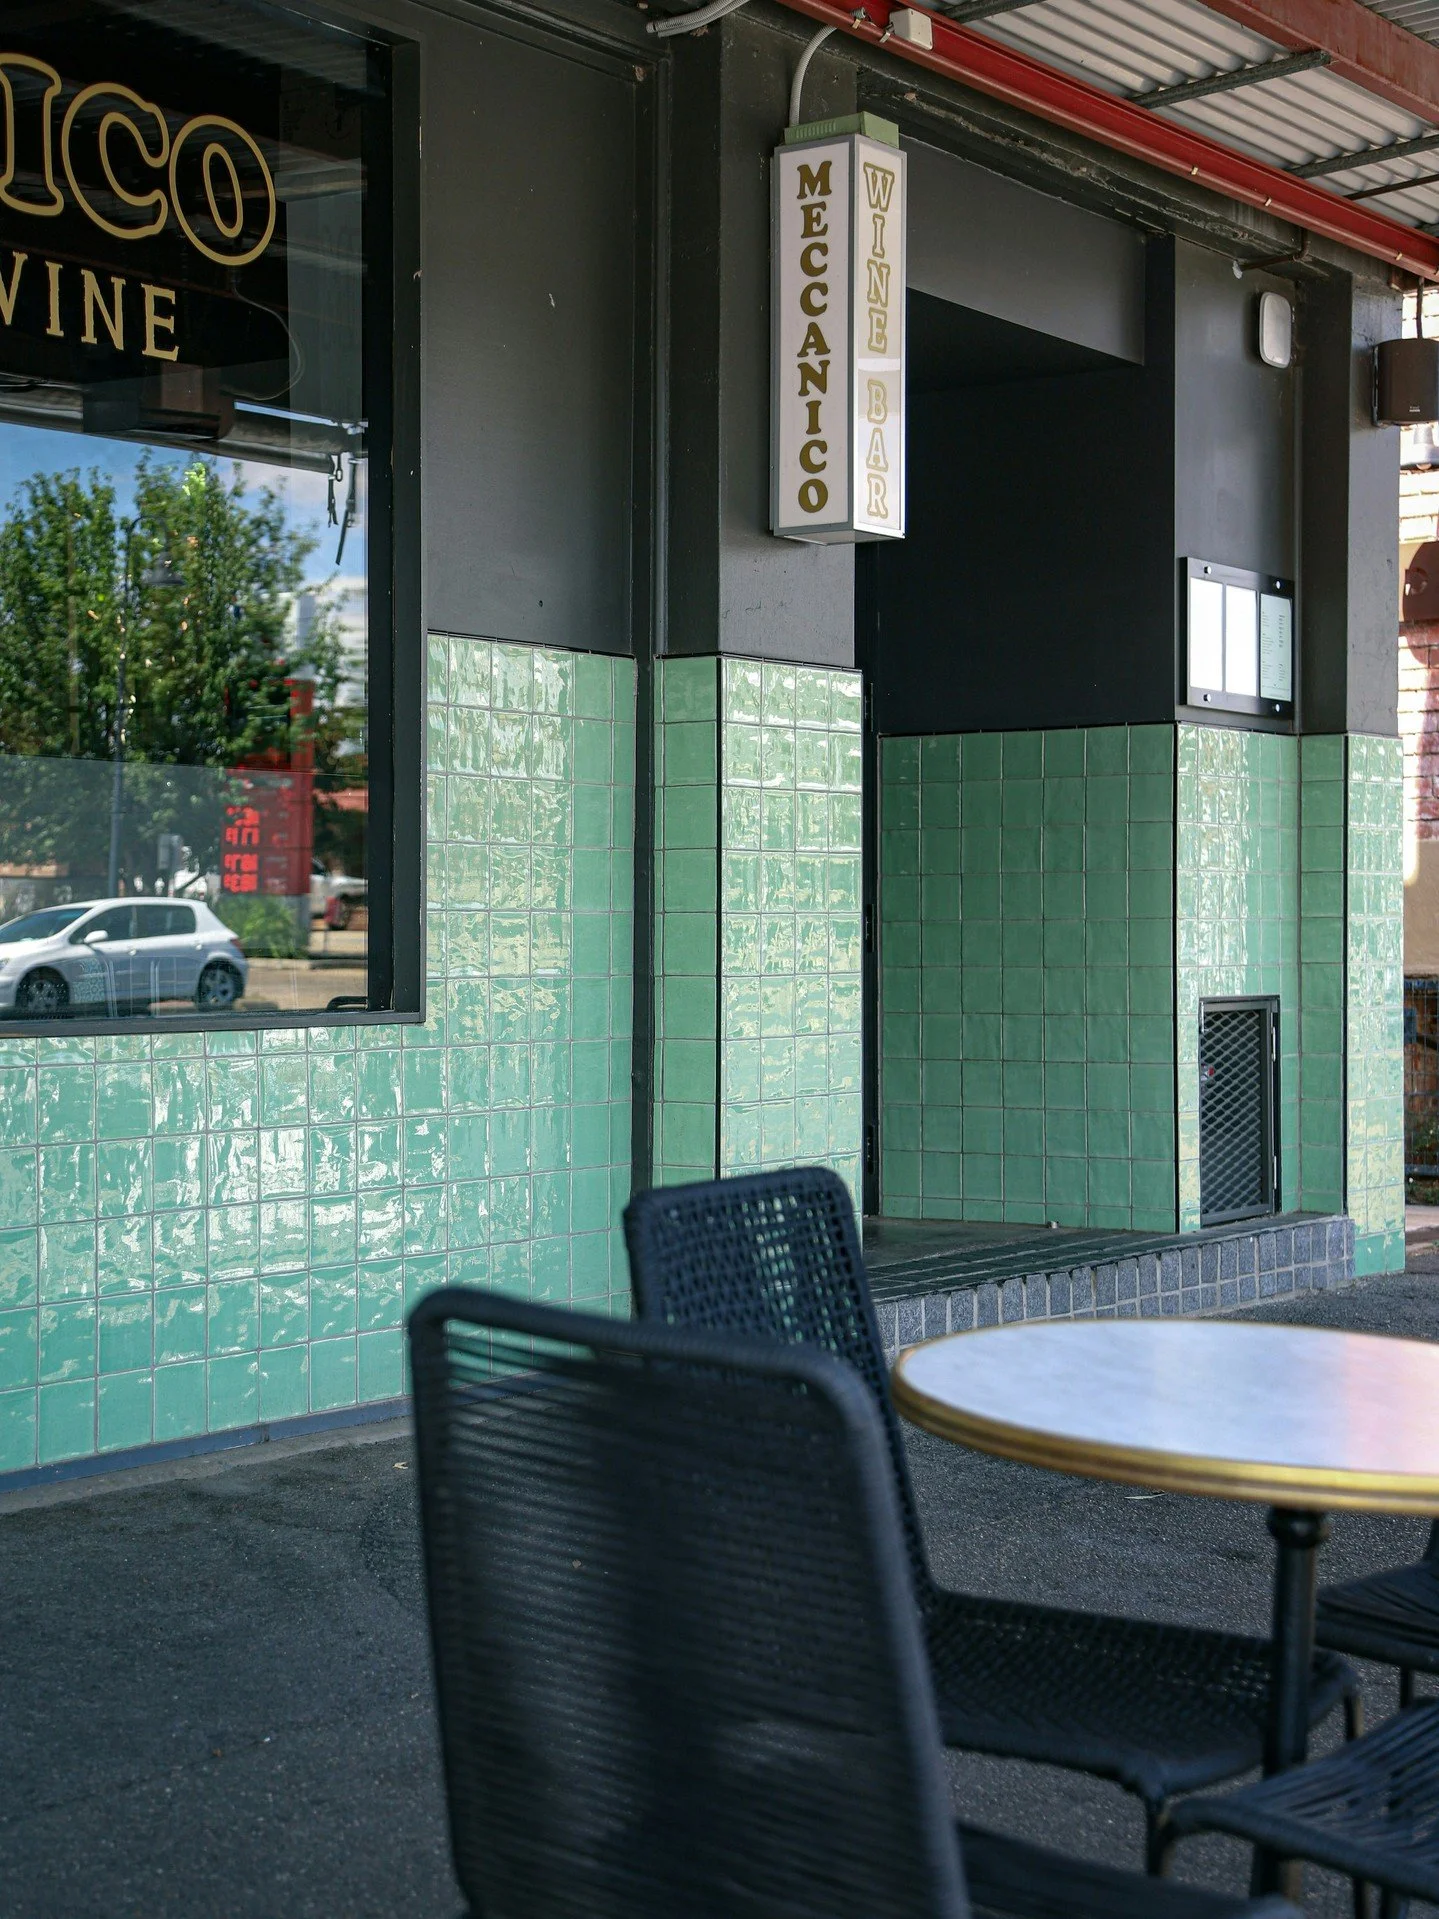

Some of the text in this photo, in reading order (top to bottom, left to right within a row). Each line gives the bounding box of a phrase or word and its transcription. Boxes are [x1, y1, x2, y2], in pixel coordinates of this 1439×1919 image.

[797, 160, 833, 514] MECCANICO
[863, 161, 895, 519] WINE BAR
